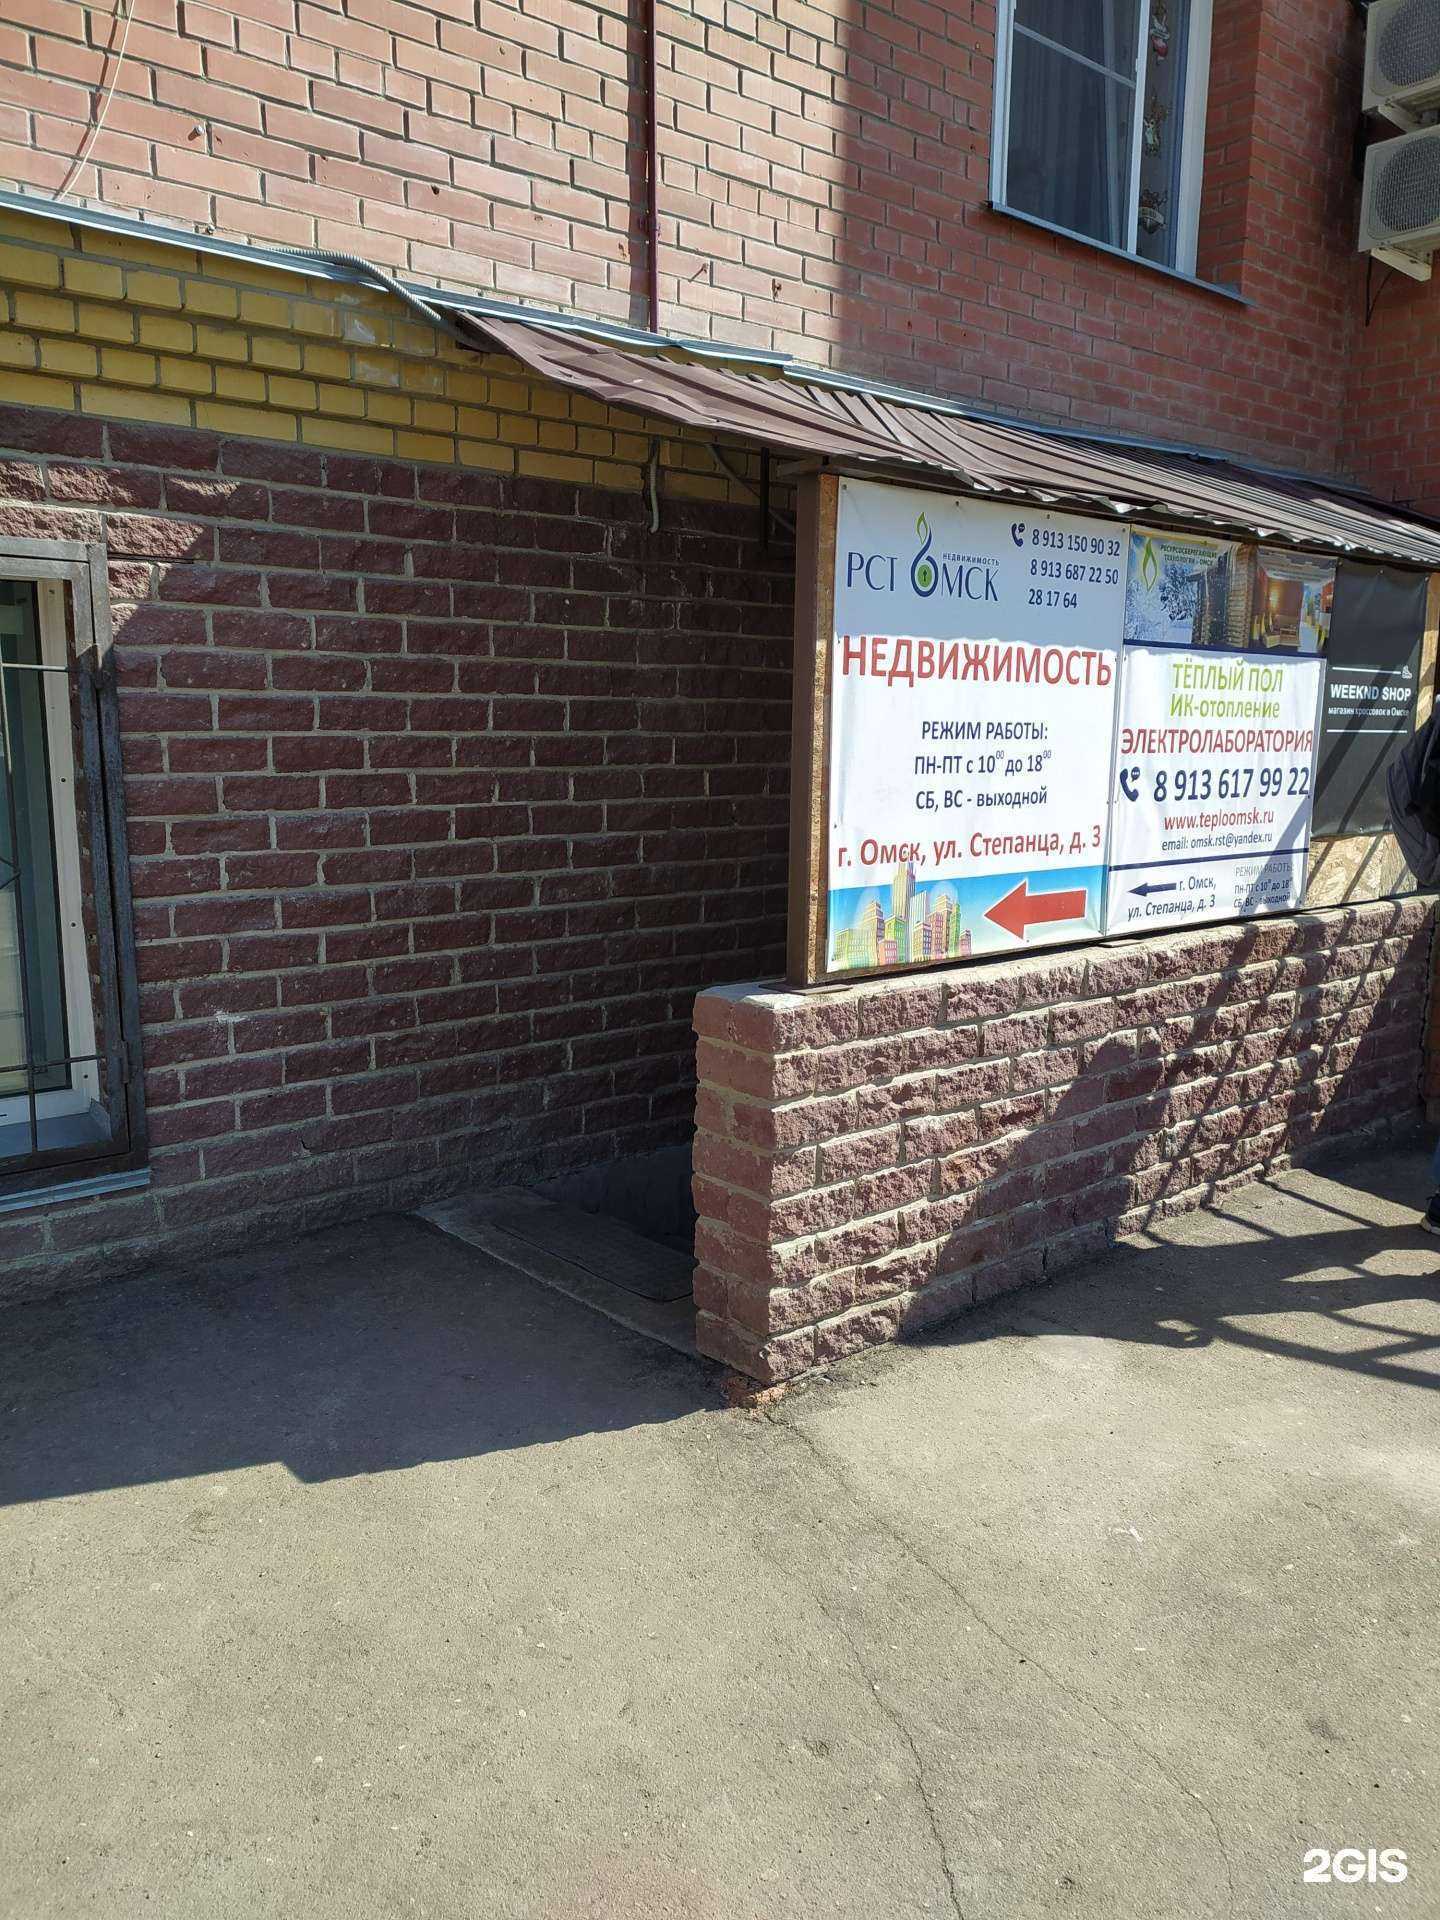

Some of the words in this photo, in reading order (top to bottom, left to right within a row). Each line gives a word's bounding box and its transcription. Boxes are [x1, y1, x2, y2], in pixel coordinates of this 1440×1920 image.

[1032, 529, 1039, 545] 8
[1042, 530, 1064, 549] 913
[1068, 534, 1088, 552] 150
[1090, 536, 1104, 555] 90
[1107, 539, 1121, 556] 32
[847, 552, 898, 592] РСТ
[1030, 558, 1037, 575] 8
[1041, 560, 1061, 579] 913
[1065, 562, 1086, 582] 687
[1089, 565, 1102, 583] 22
[1105, 567, 1119, 585] 50
[1029, 588, 1042, 605] 28
[1046, 590, 1060, 607] 17
[1063, 592, 1077, 609] 64
[843, 635, 1112, 688] НЕДВИЖИМОСТЬ
[1172, 658, 1245, 692] ТЁПЛЫЙ
[1249, 668, 1283, 693] ПОЛ
[1330, 684, 1379, 699] WEEKND
[1382, 686, 1411, 701] SHOP
[1170, 693, 1280, 719] ИК-отопление
[1328, 707, 1354, 715] магазин
[922, 721, 981, 740] РЕЖИМ
[986, 721, 1048, 740] РАБОТЫ:
[1120, 728, 1314, 754] ЭЛЕКТРОЛАБОРАТОРИЯ
[914, 756, 962, 775] ПН-ПТ
[966, 761, 973, 774] с
[1005, 757, 1023, 777] до
[1154, 770, 1167, 802] 8
[1174, 769, 1212, 801] 913
[1218, 768, 1253, 799] 617
[1259, 767, 1283, 797] 99
[1287, 767, 1310, 796] 22
[916, 790, 938, 812] СБ,
[944, 790, 963, 809] ВС
[977, 785, 1048, 808] выходной
[1164, 806, 1275, 832] www.teploomsk.ru
[838, 846, 852, 867] г.
[860, 838, 926, 867] Омск,
[933, 840, 962, 865] ул.
[970, 831, 1064, 857] Степанца,
[1070, 831, 1086, 852] д.
[1092, 825, 1101, 847] 3
[1161, 837, 1188, 851] email:
[1191, 832, 1273, 849] omsk.rst@yandex.ru
[1179, 880, 1185, 891] г.
[1188, 876, 1216, 890] Омск,
[1128, 906, 1142, 922] ул.
[1145, 900, 1195, 916] Степанца,
[1197, 898, 1206, 912] д.
[1210, 894, 1216, 908] 3
